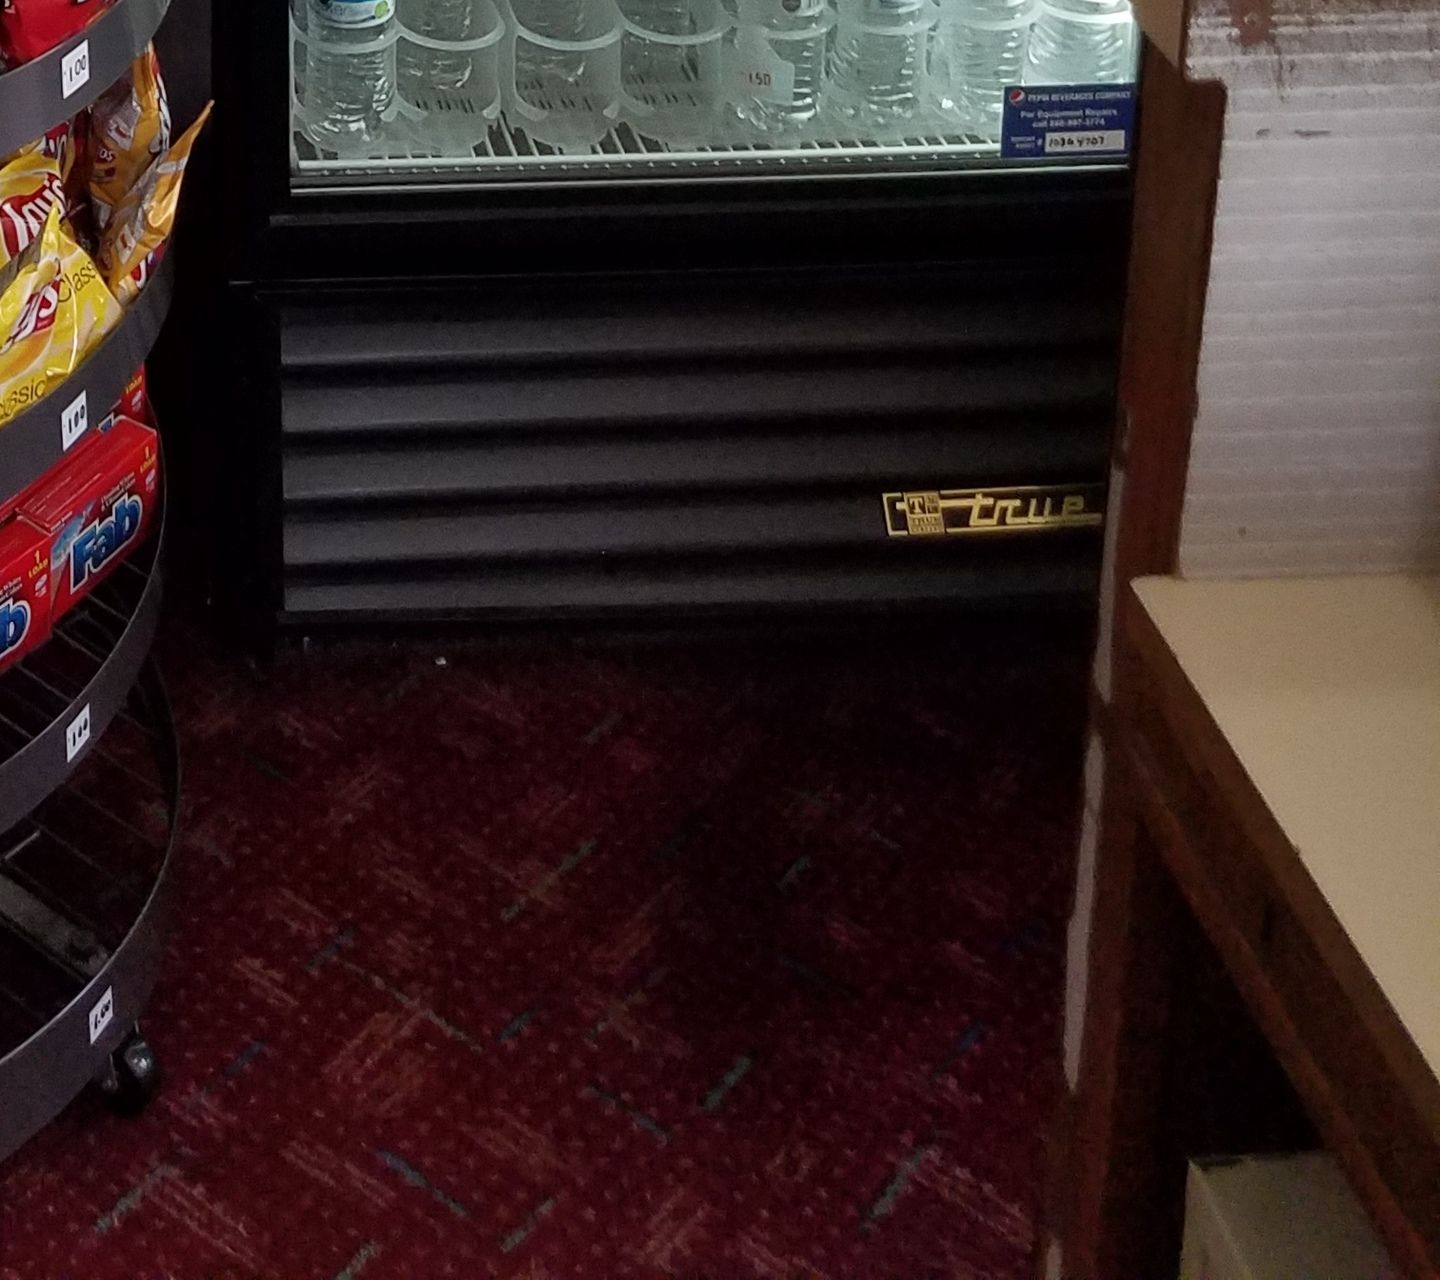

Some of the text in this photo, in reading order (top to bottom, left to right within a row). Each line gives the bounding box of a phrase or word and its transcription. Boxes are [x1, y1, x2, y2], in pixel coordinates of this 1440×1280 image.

[58, 260, 97, 304] Class
[969, 493, 1085, 528] true
[70, 493, 144, 594] Fab
